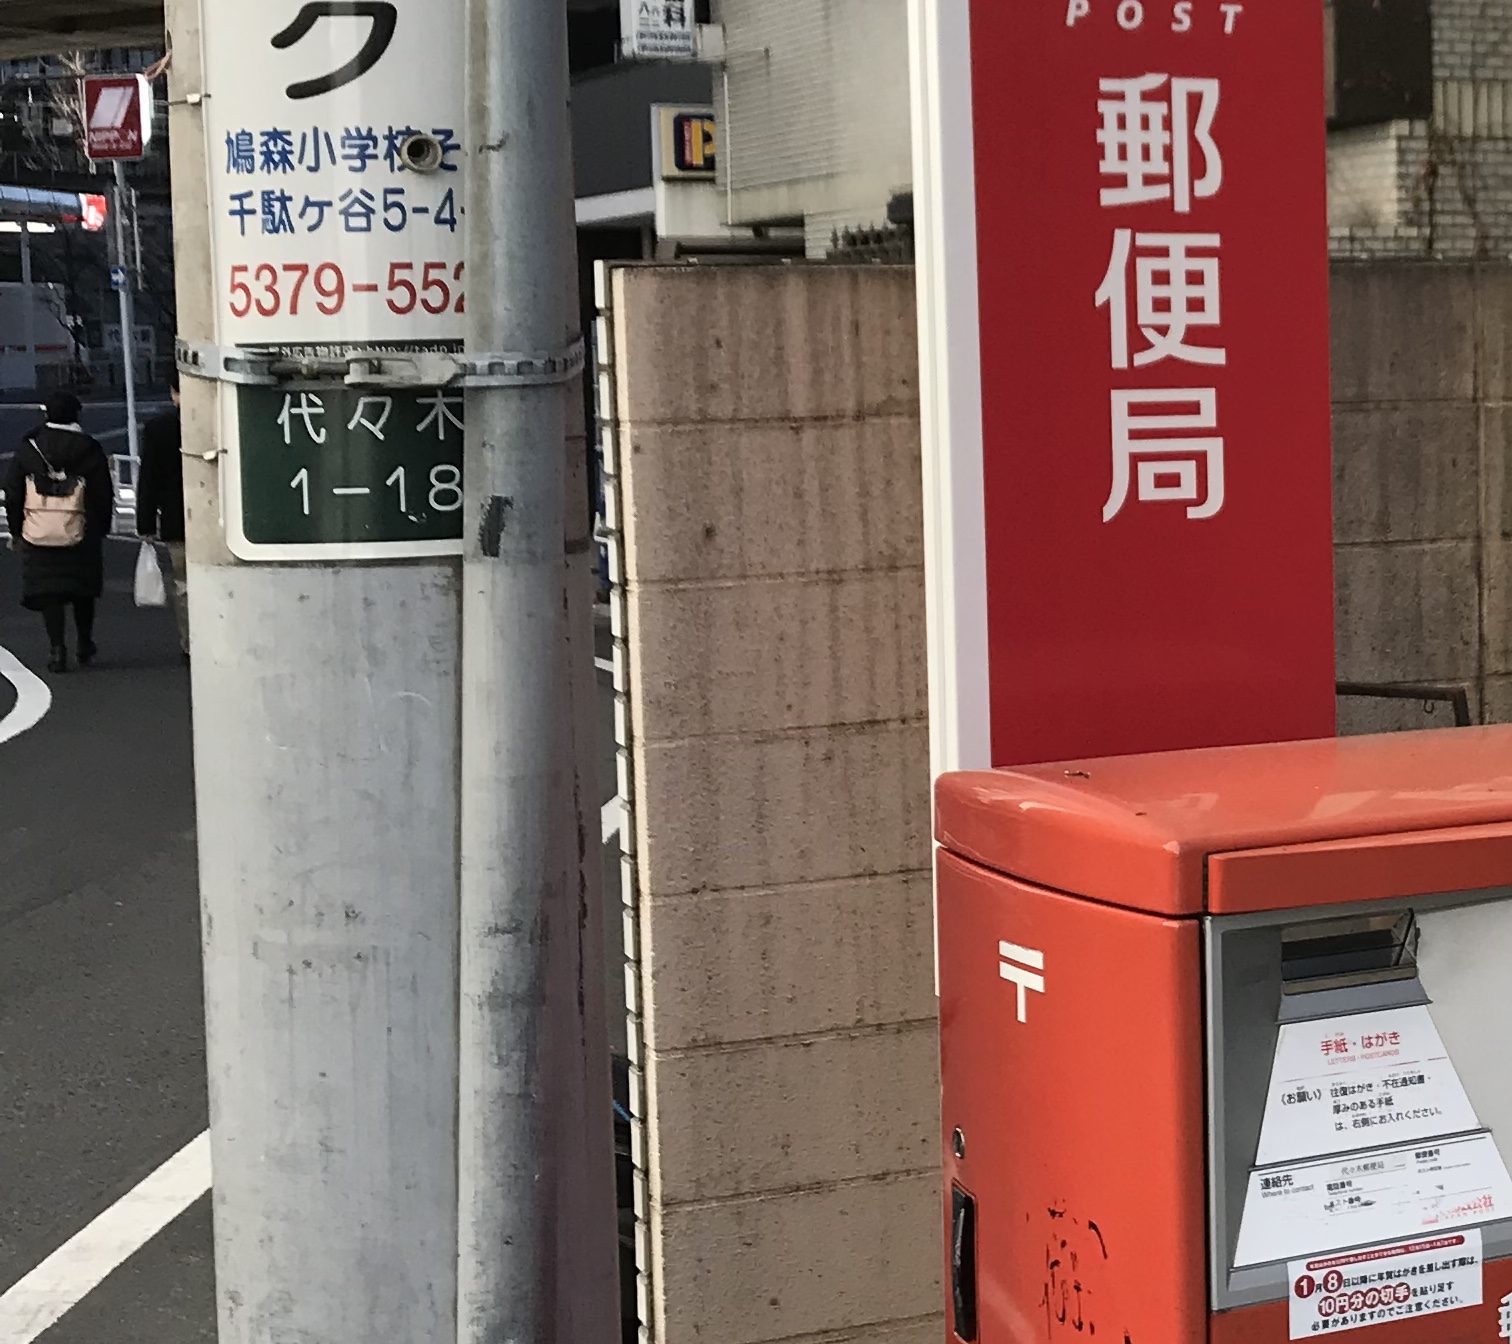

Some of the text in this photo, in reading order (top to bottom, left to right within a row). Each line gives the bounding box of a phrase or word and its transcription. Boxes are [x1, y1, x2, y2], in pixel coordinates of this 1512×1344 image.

[1094, 71, 1227, 524] 郵便局
[1321, 1031, 1401, 1056] 手紙・はがき
[1260, 1174, 1294, 1190] 連絡先
